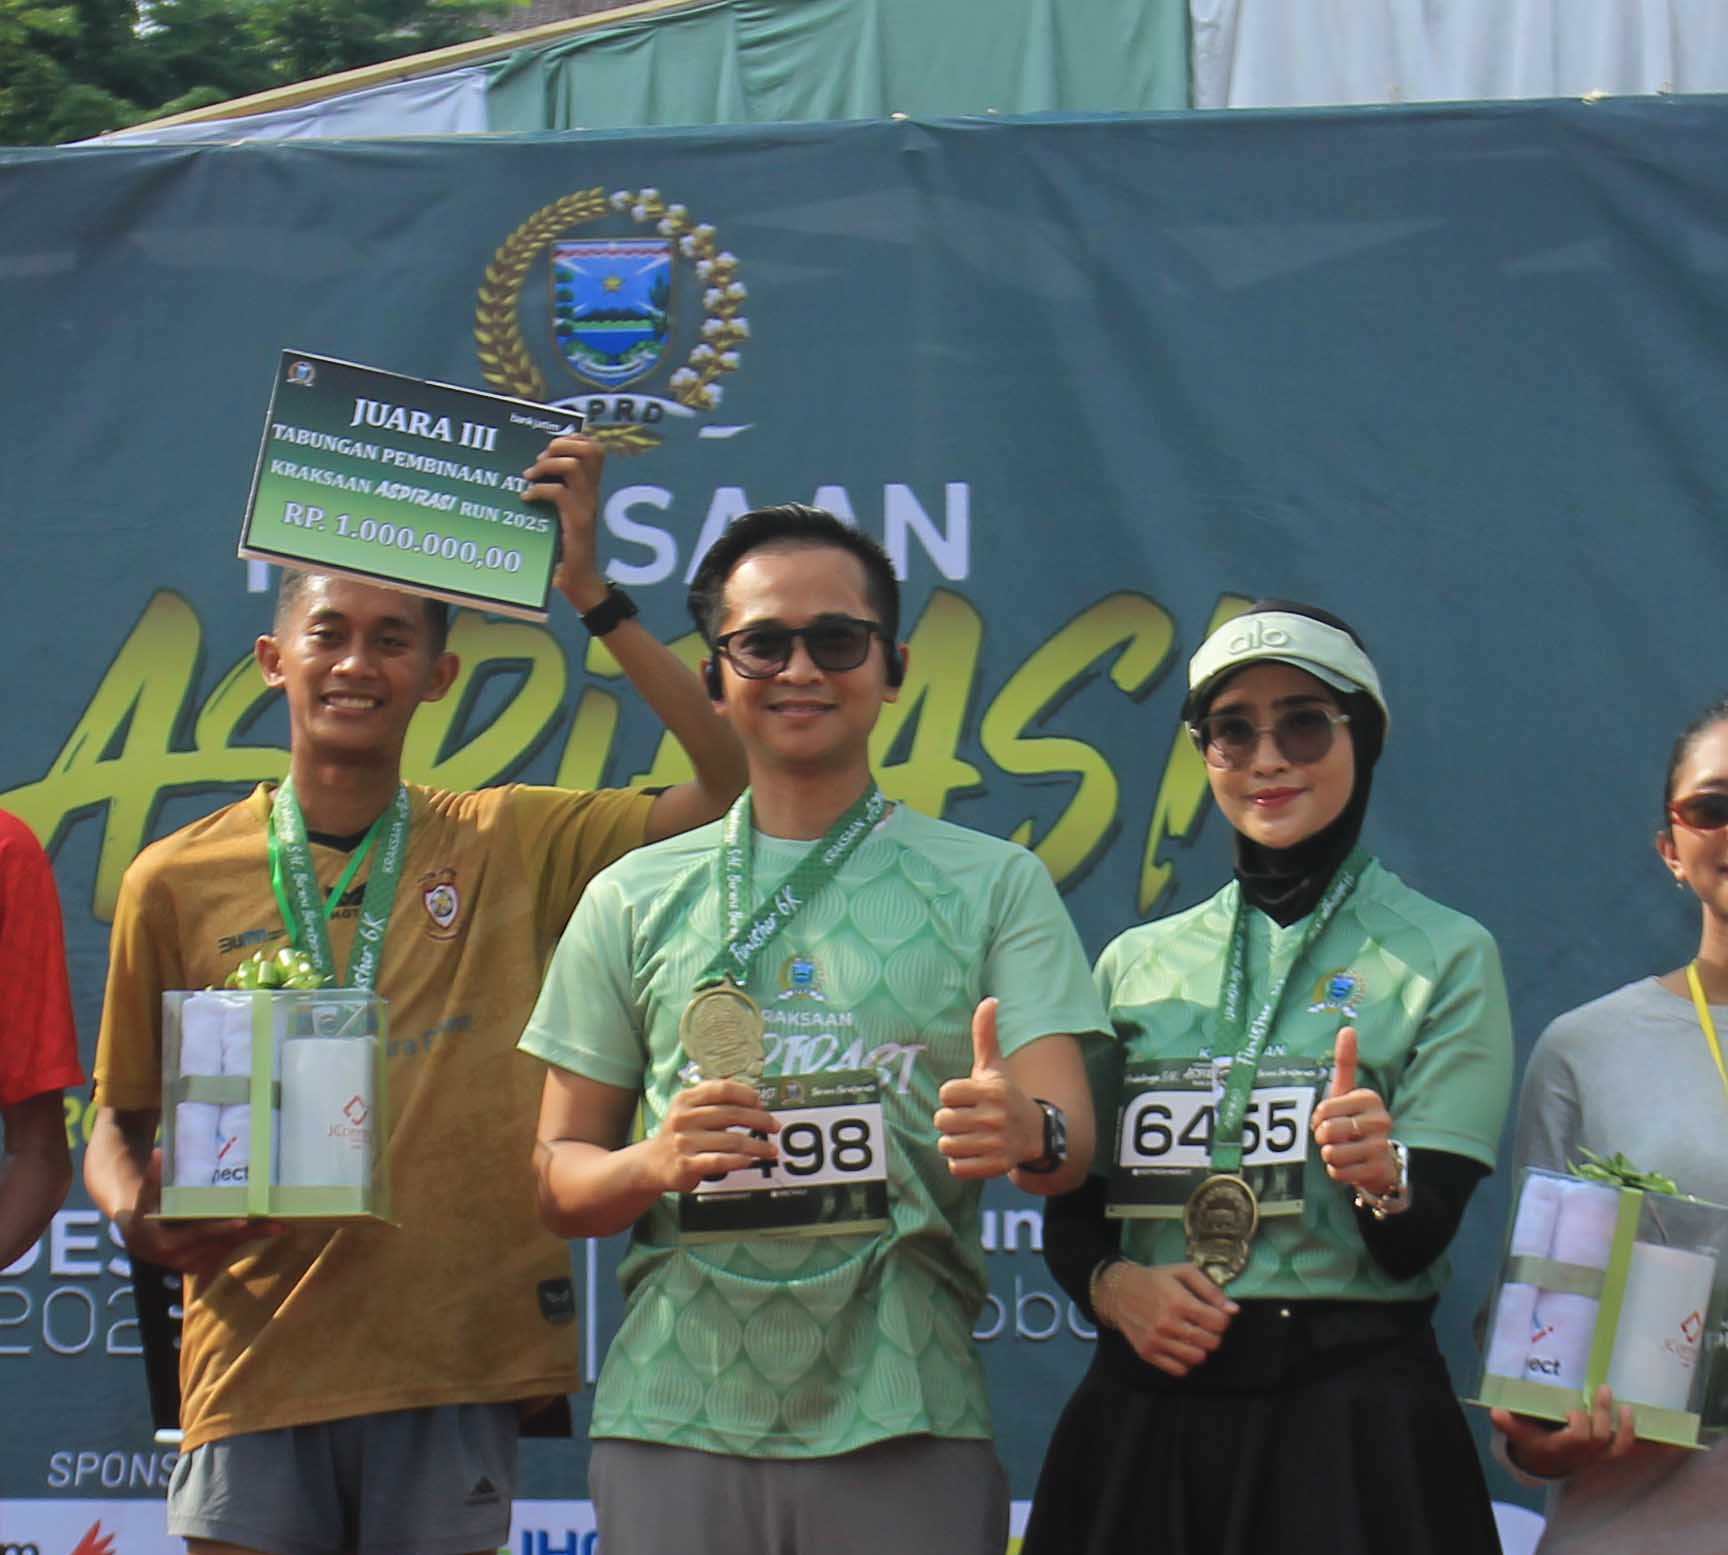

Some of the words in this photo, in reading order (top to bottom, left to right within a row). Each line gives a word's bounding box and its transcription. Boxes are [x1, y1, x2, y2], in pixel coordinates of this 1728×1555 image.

[351, 398, 452, 442] JUARA
[458, 423, 499, 451] III
[560, 398, 663, 424] PRD
[272, 423, 378, 461] TABUNGAN
[381, 450, 500, 488] PEMBINAAN
[270, 459, 371, 493] KRAKSAAN
[374, 480, 458, 512] ASPIRASI
[460, 502, 499, 522] RUN
[502, 511, 550, 533] 2025
[282, 502, 326, 531] RP.
[335, 514, 522, 573] 1.000.000,00
[775, 883, 802, 916] 6K
[359, 912, 386, 941] 6K
[761, 1010, 854, 1027] RAKSAAN
